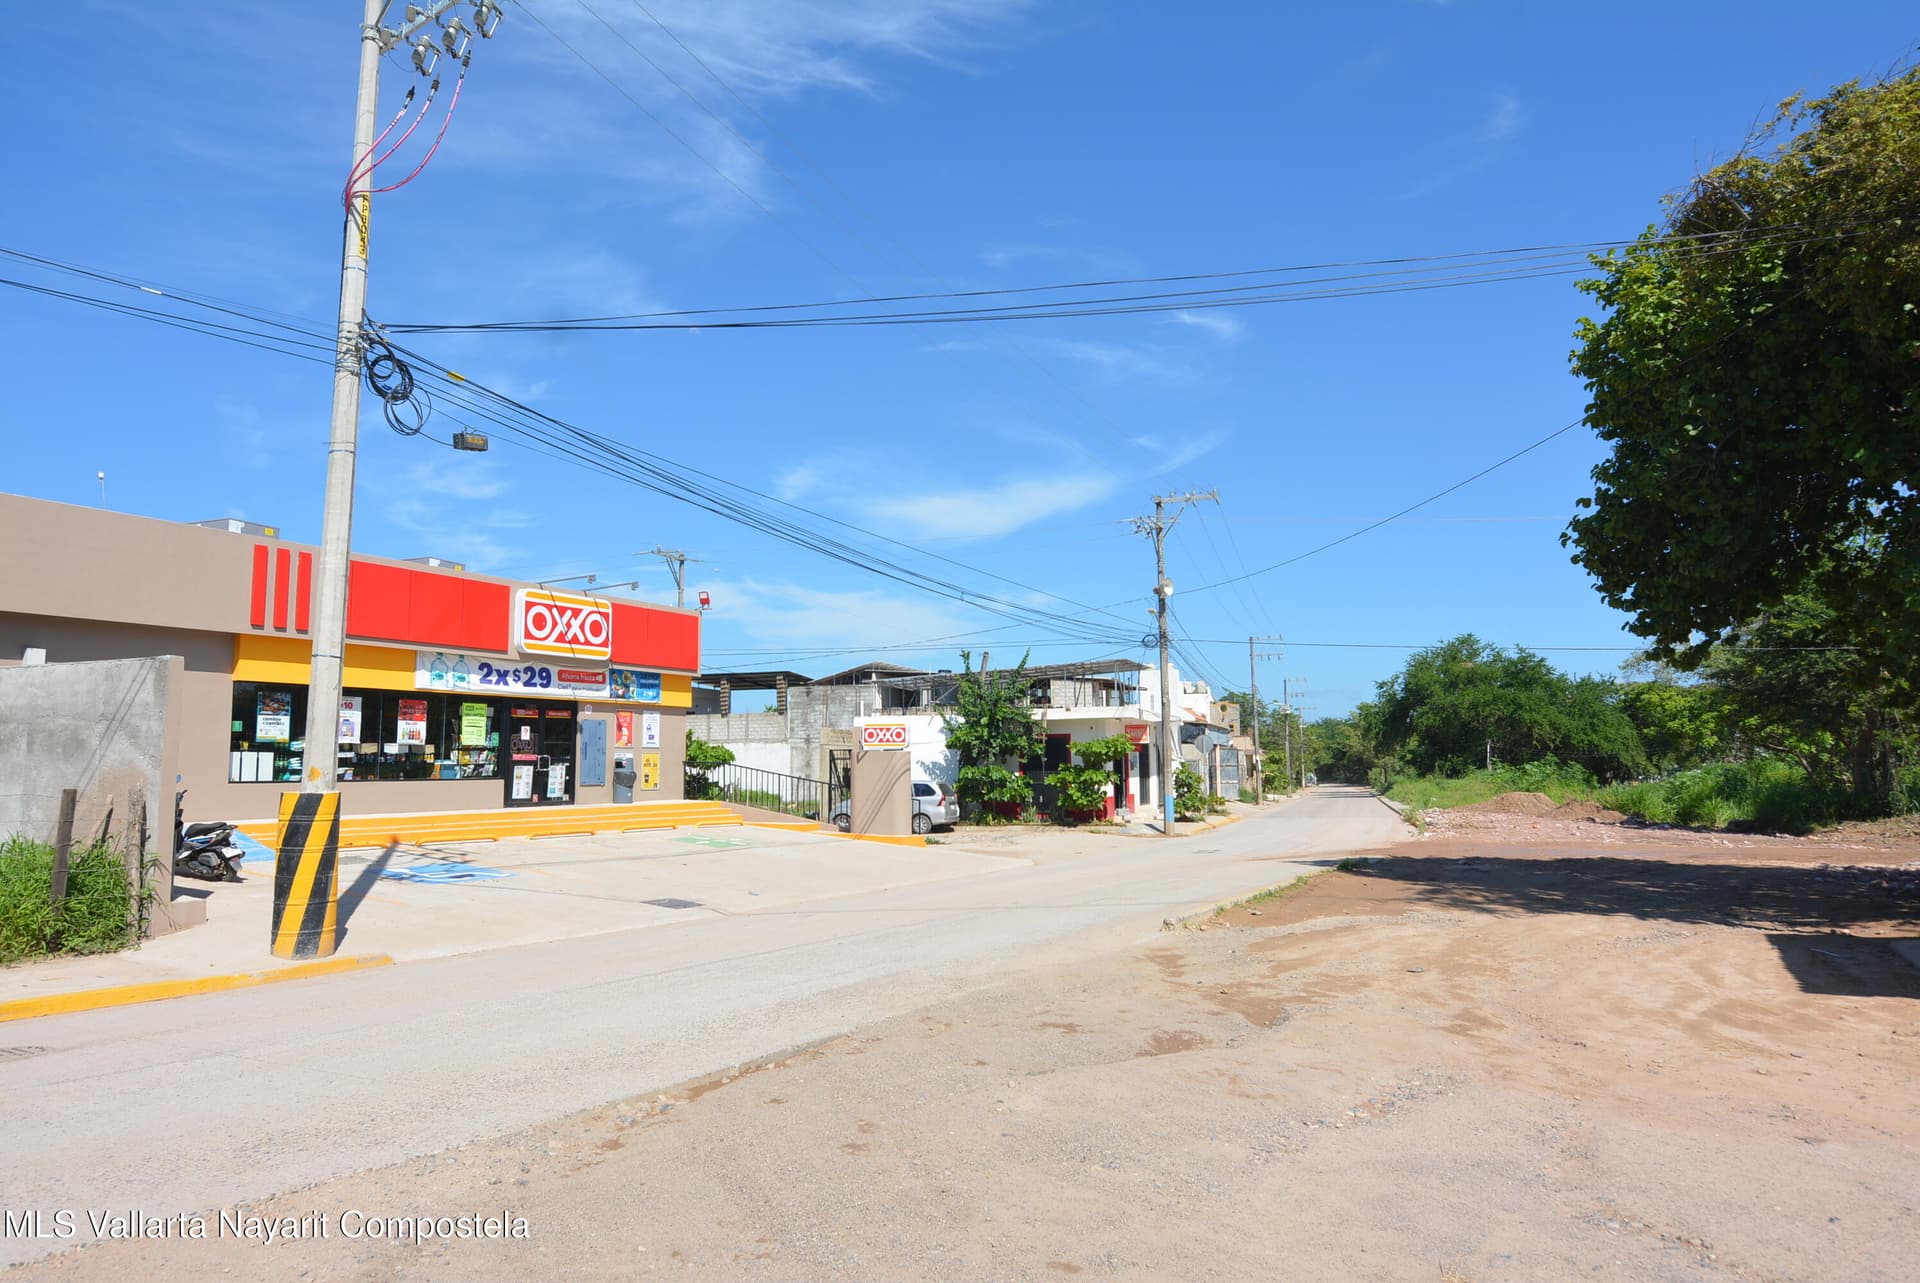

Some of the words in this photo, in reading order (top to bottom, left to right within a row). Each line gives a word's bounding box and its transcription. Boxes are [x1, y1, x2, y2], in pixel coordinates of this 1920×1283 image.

[527, 605, 608, 644] OXXO
[478, 661, 552, 688] 2x$29
[865, 729, 904, 742] OXXO
